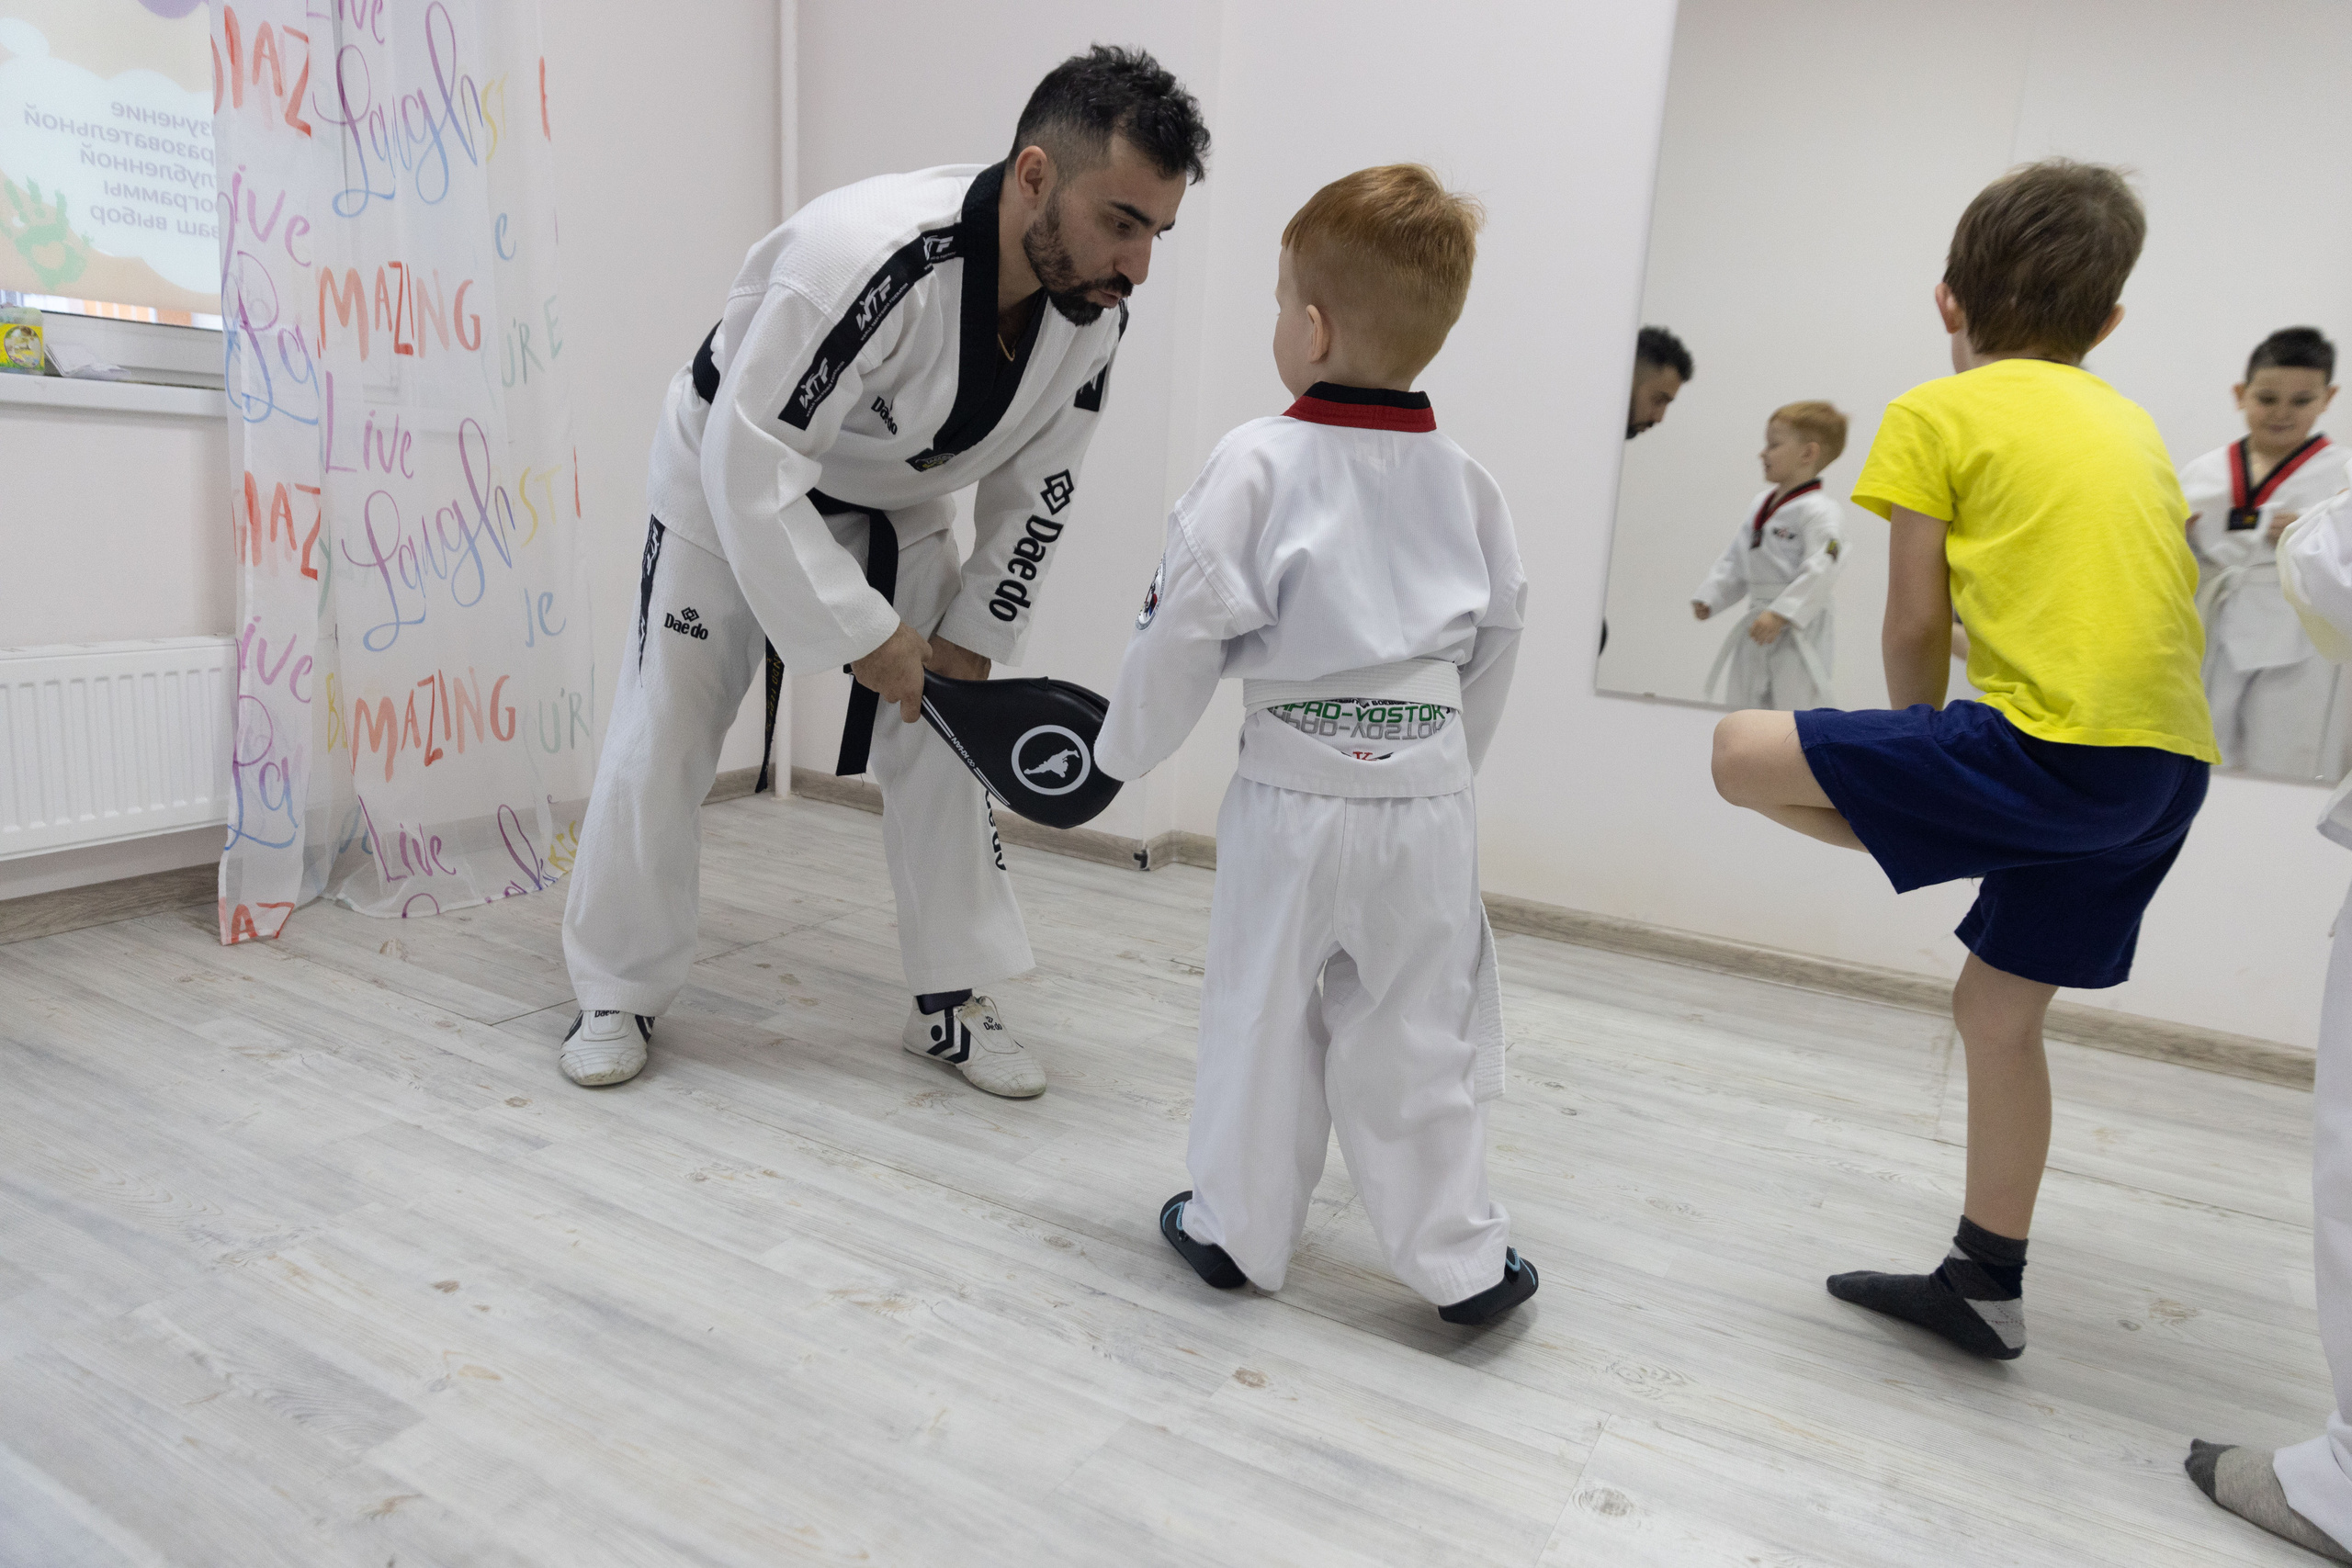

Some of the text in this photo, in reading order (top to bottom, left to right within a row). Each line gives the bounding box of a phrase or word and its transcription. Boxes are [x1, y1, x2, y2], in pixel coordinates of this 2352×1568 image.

[324, 369, 414, 479] Live
[988, 513, 1065, 623] Daedo
[663, 612, 709, 641] Daedo
[951, 737, 970, 759] KHAN
[357, 794, 458, 883] Live
